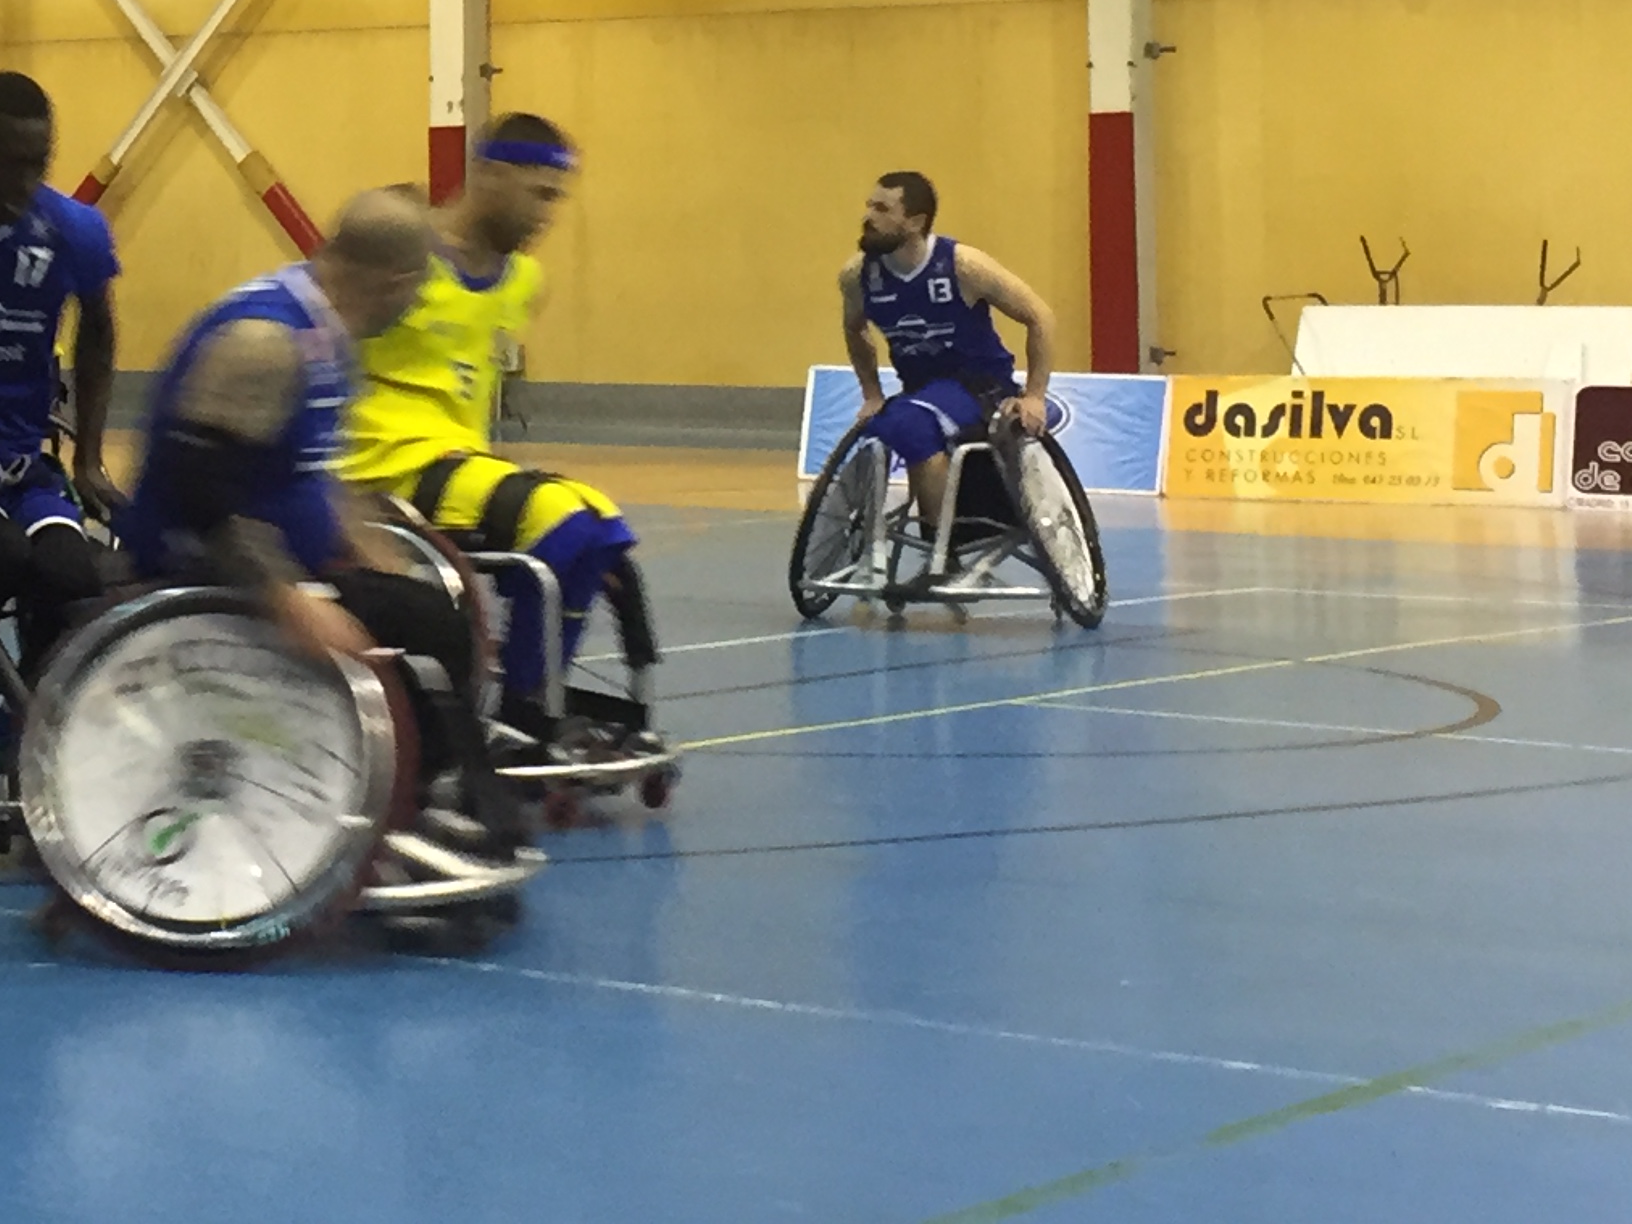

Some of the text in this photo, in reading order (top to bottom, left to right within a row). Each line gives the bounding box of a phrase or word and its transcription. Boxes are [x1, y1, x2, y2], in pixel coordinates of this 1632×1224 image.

[927, 277, 953, 303] 13
[1183, 389, 1394, 440] dasilva
[1184, 448, 1388, 466] CONSTRUCCIONES
[1183, 467, 1194, 483] Y
[1205, 469, 1317, 485] REFORMAS
[1574, 460, 1622, 491] de
